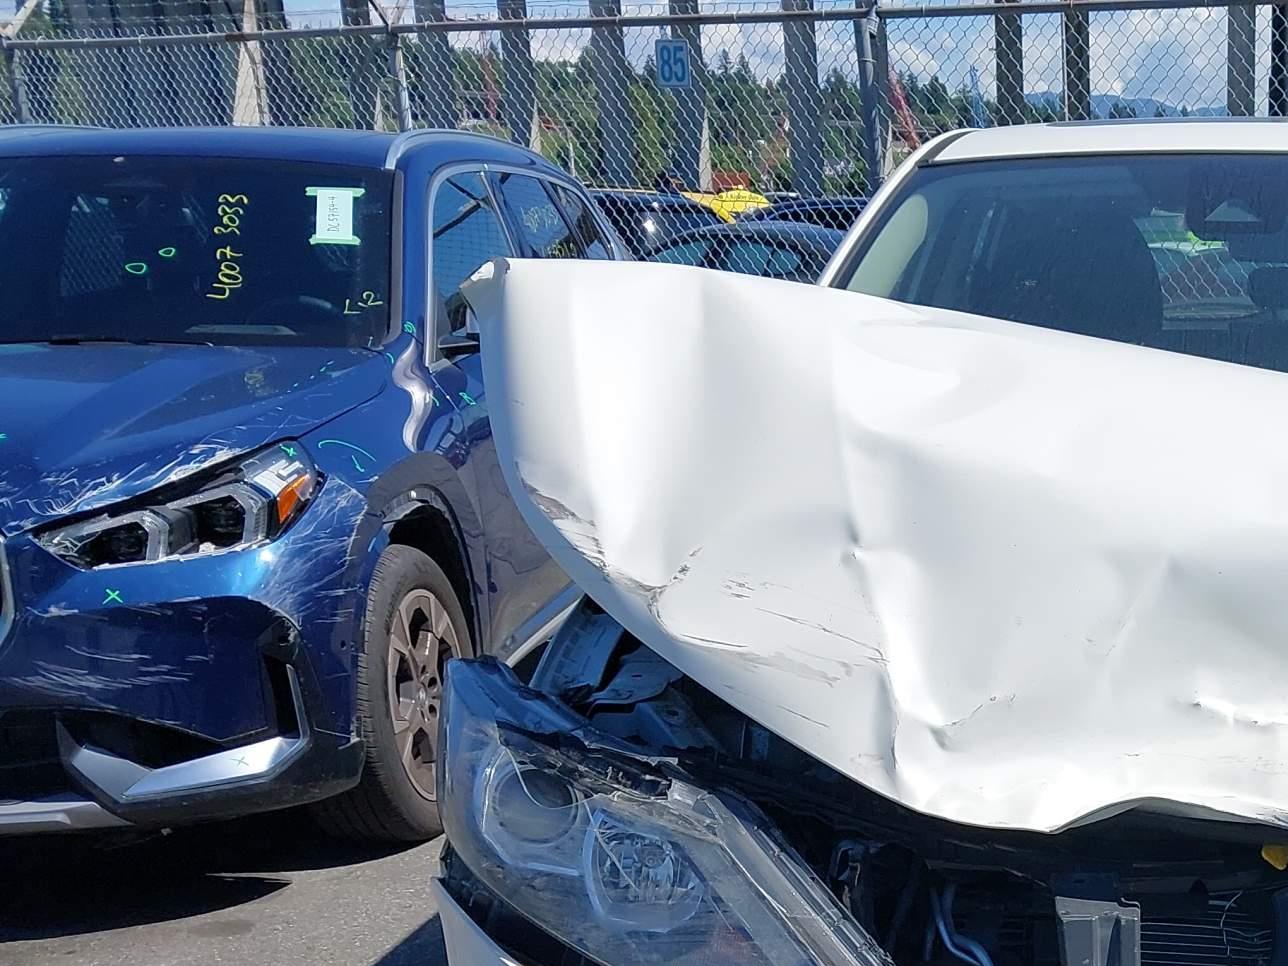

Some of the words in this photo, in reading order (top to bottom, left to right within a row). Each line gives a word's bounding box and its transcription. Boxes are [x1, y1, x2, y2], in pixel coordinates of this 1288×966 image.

[660, 45, 686, 82] 85
[213, 193, 249, 236] 3033
[206, 246, 244, 299] 4007
